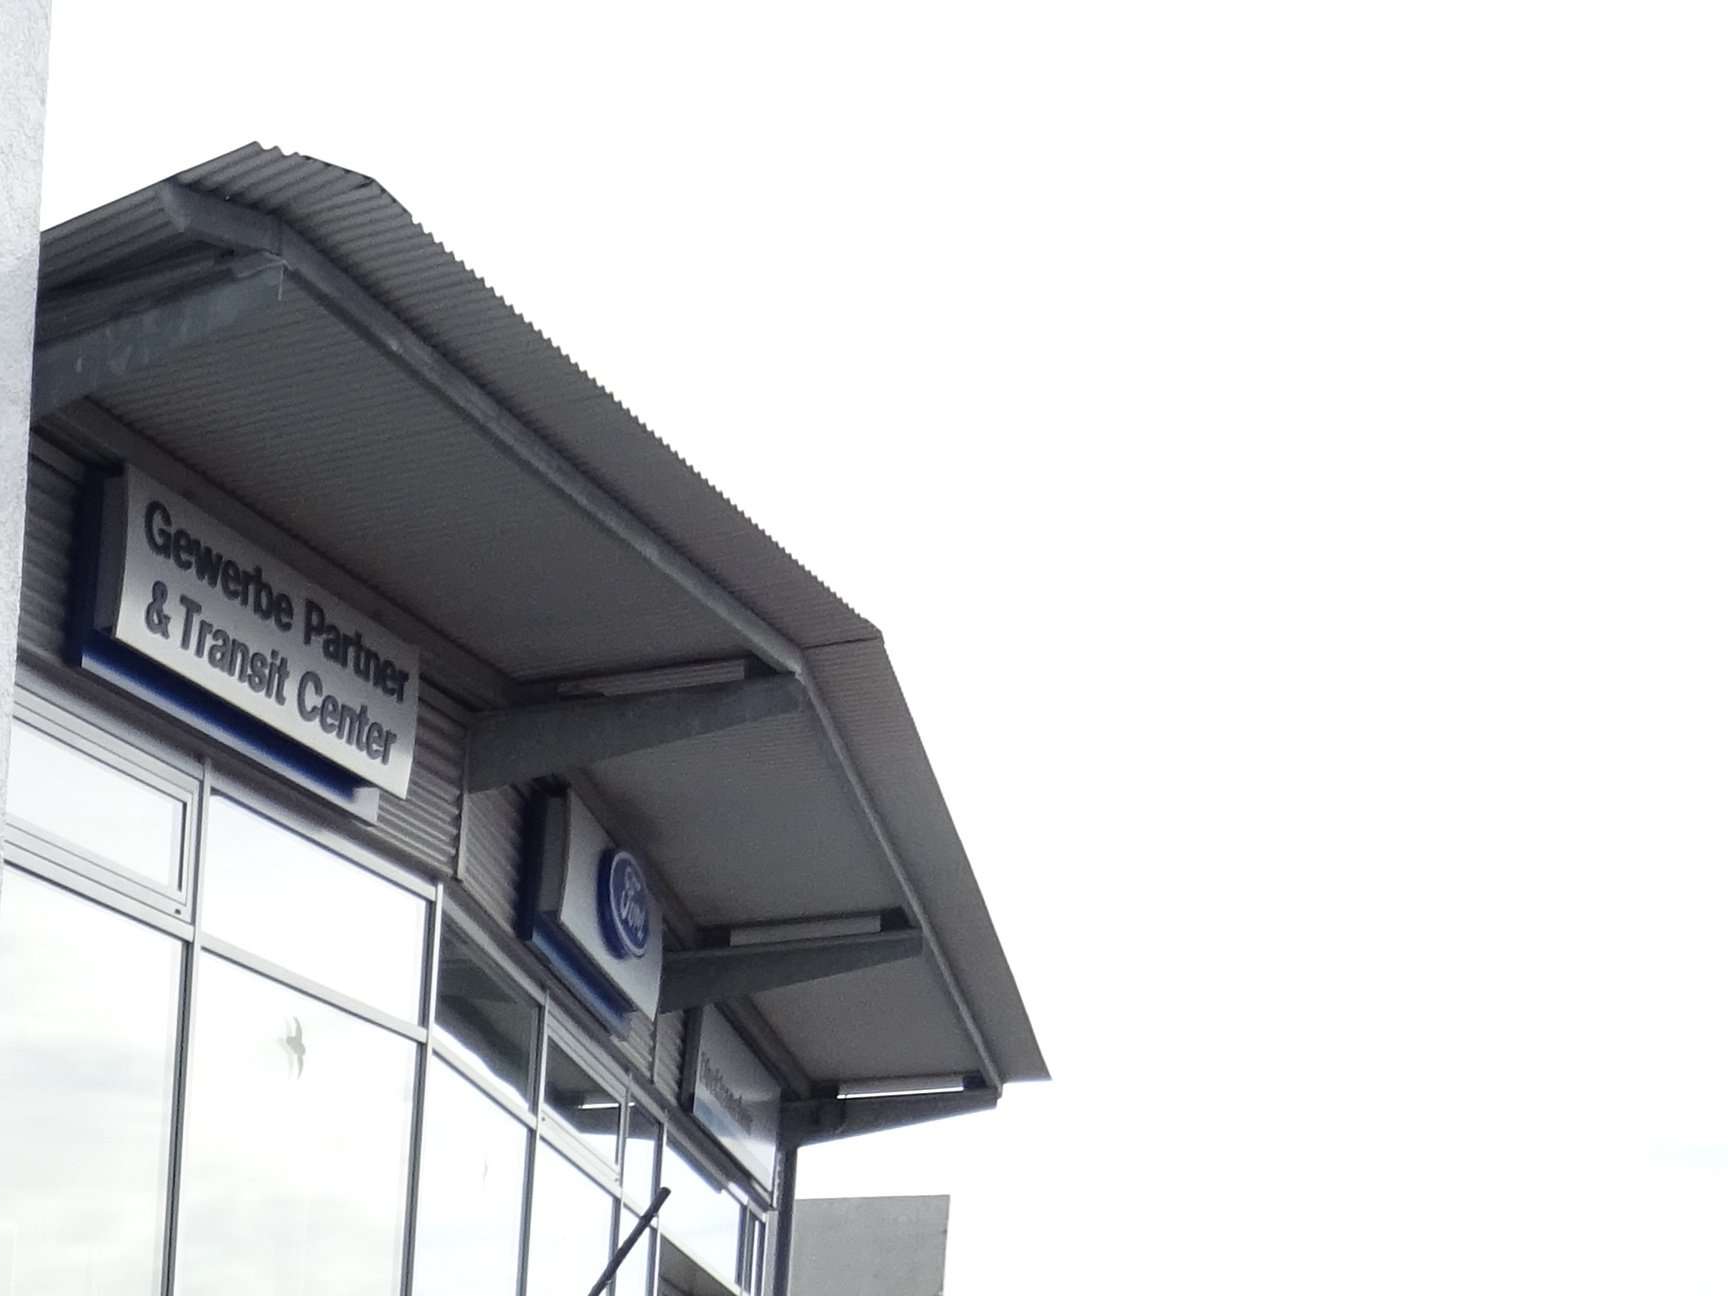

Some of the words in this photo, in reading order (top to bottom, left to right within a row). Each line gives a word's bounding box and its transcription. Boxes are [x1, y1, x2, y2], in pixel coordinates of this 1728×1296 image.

[144, 500, 293, 632] Gewerbe
[303, 599, 409, 703] Partner
[145, 580, 170, 639] &
[179, 593, 290, 706] Transit
[297, 671, 397, 765] Center
